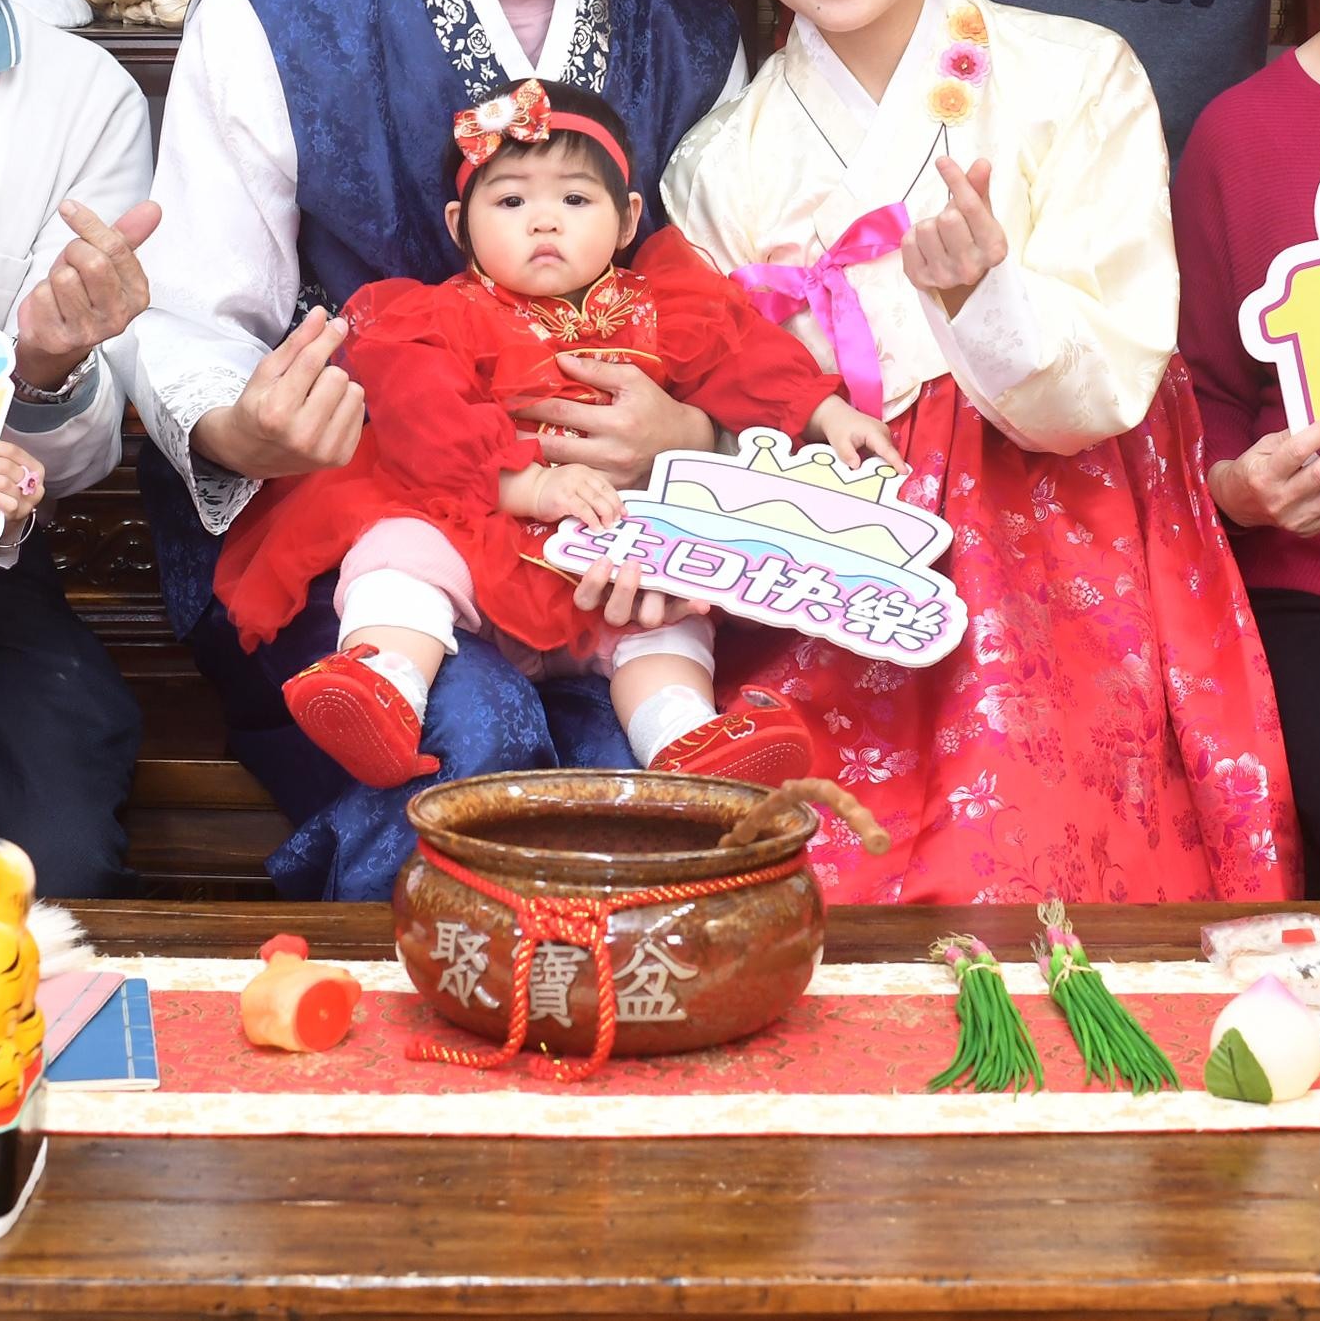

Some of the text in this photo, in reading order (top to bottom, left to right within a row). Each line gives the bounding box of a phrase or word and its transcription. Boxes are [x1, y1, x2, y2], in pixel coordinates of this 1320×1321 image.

[565, 519, 947, 652] 生日快樂
[429, 919, 700, 1029] 聚寶盆
